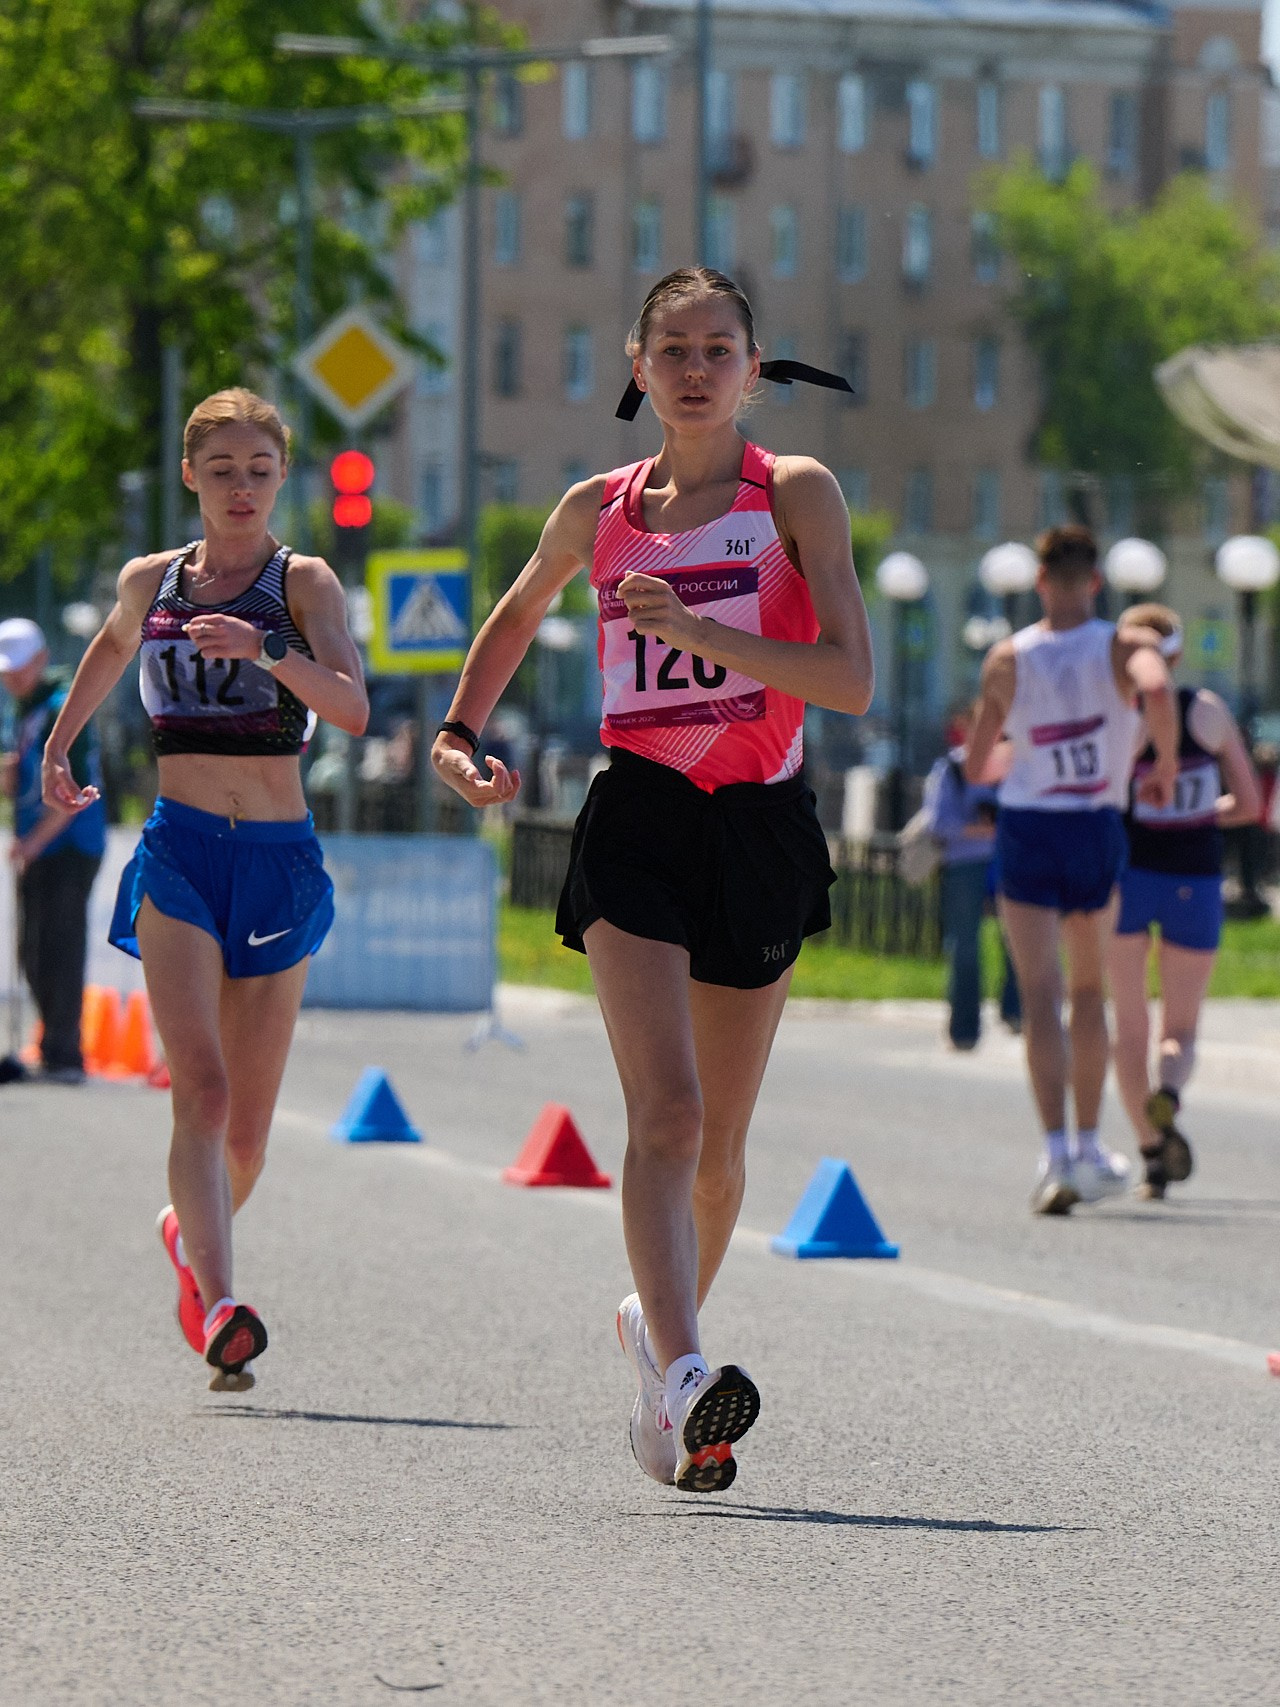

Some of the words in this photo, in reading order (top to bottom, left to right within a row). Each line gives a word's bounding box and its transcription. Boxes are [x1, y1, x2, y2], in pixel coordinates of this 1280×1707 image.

[679, 579, 738, 594] РОССИИ
[160, 645, 245, 705] 112
[1174, 775, 1203, 810] 17
